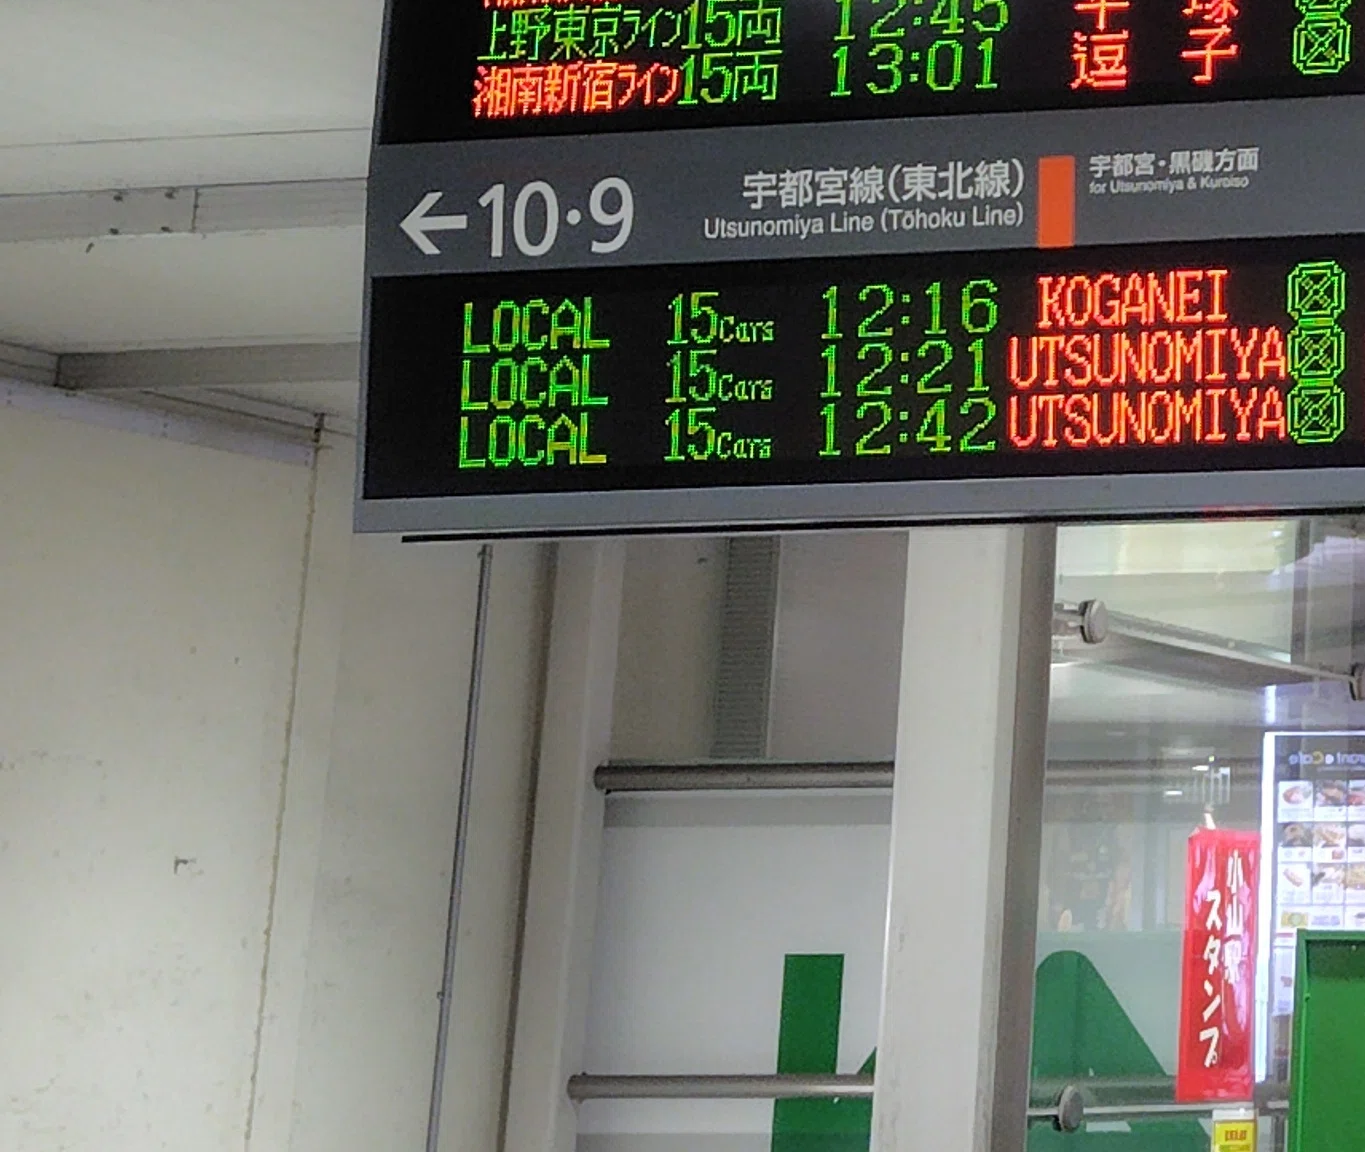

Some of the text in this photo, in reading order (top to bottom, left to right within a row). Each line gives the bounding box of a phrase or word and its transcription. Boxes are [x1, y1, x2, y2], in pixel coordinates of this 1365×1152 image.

[829, 35, 1000, 99] 13:01
[1089, 147, 1260, 179] 宇都宮・黒磯方面
[1089, 180, 1107, 194] for
[1110, 177, 1184, 194] Utsunomiya
[1187, 178, 1196, 190] &
[704, 201, 1024, 242] Utsunomiya Line (Tōhoku Line)
[463, 296, 611, 354] LOCAL
[820, 278, 999, 339] 12:16
[1037, 266, 1230, 331] KOGANEI
[460, 354, 609, 411] LOCAL
[819, 338, 990, 399] 12:21
[1008, 324, 1287, 389] UTSUNOMIYA
[458, 411, 607, 469] LOCAL
[818, 396, 998, 457] 12:42
[1008, 385, 1287, 448] UTSUNOMIYA
[1199, 889, 1223, 1069] スタンプ
